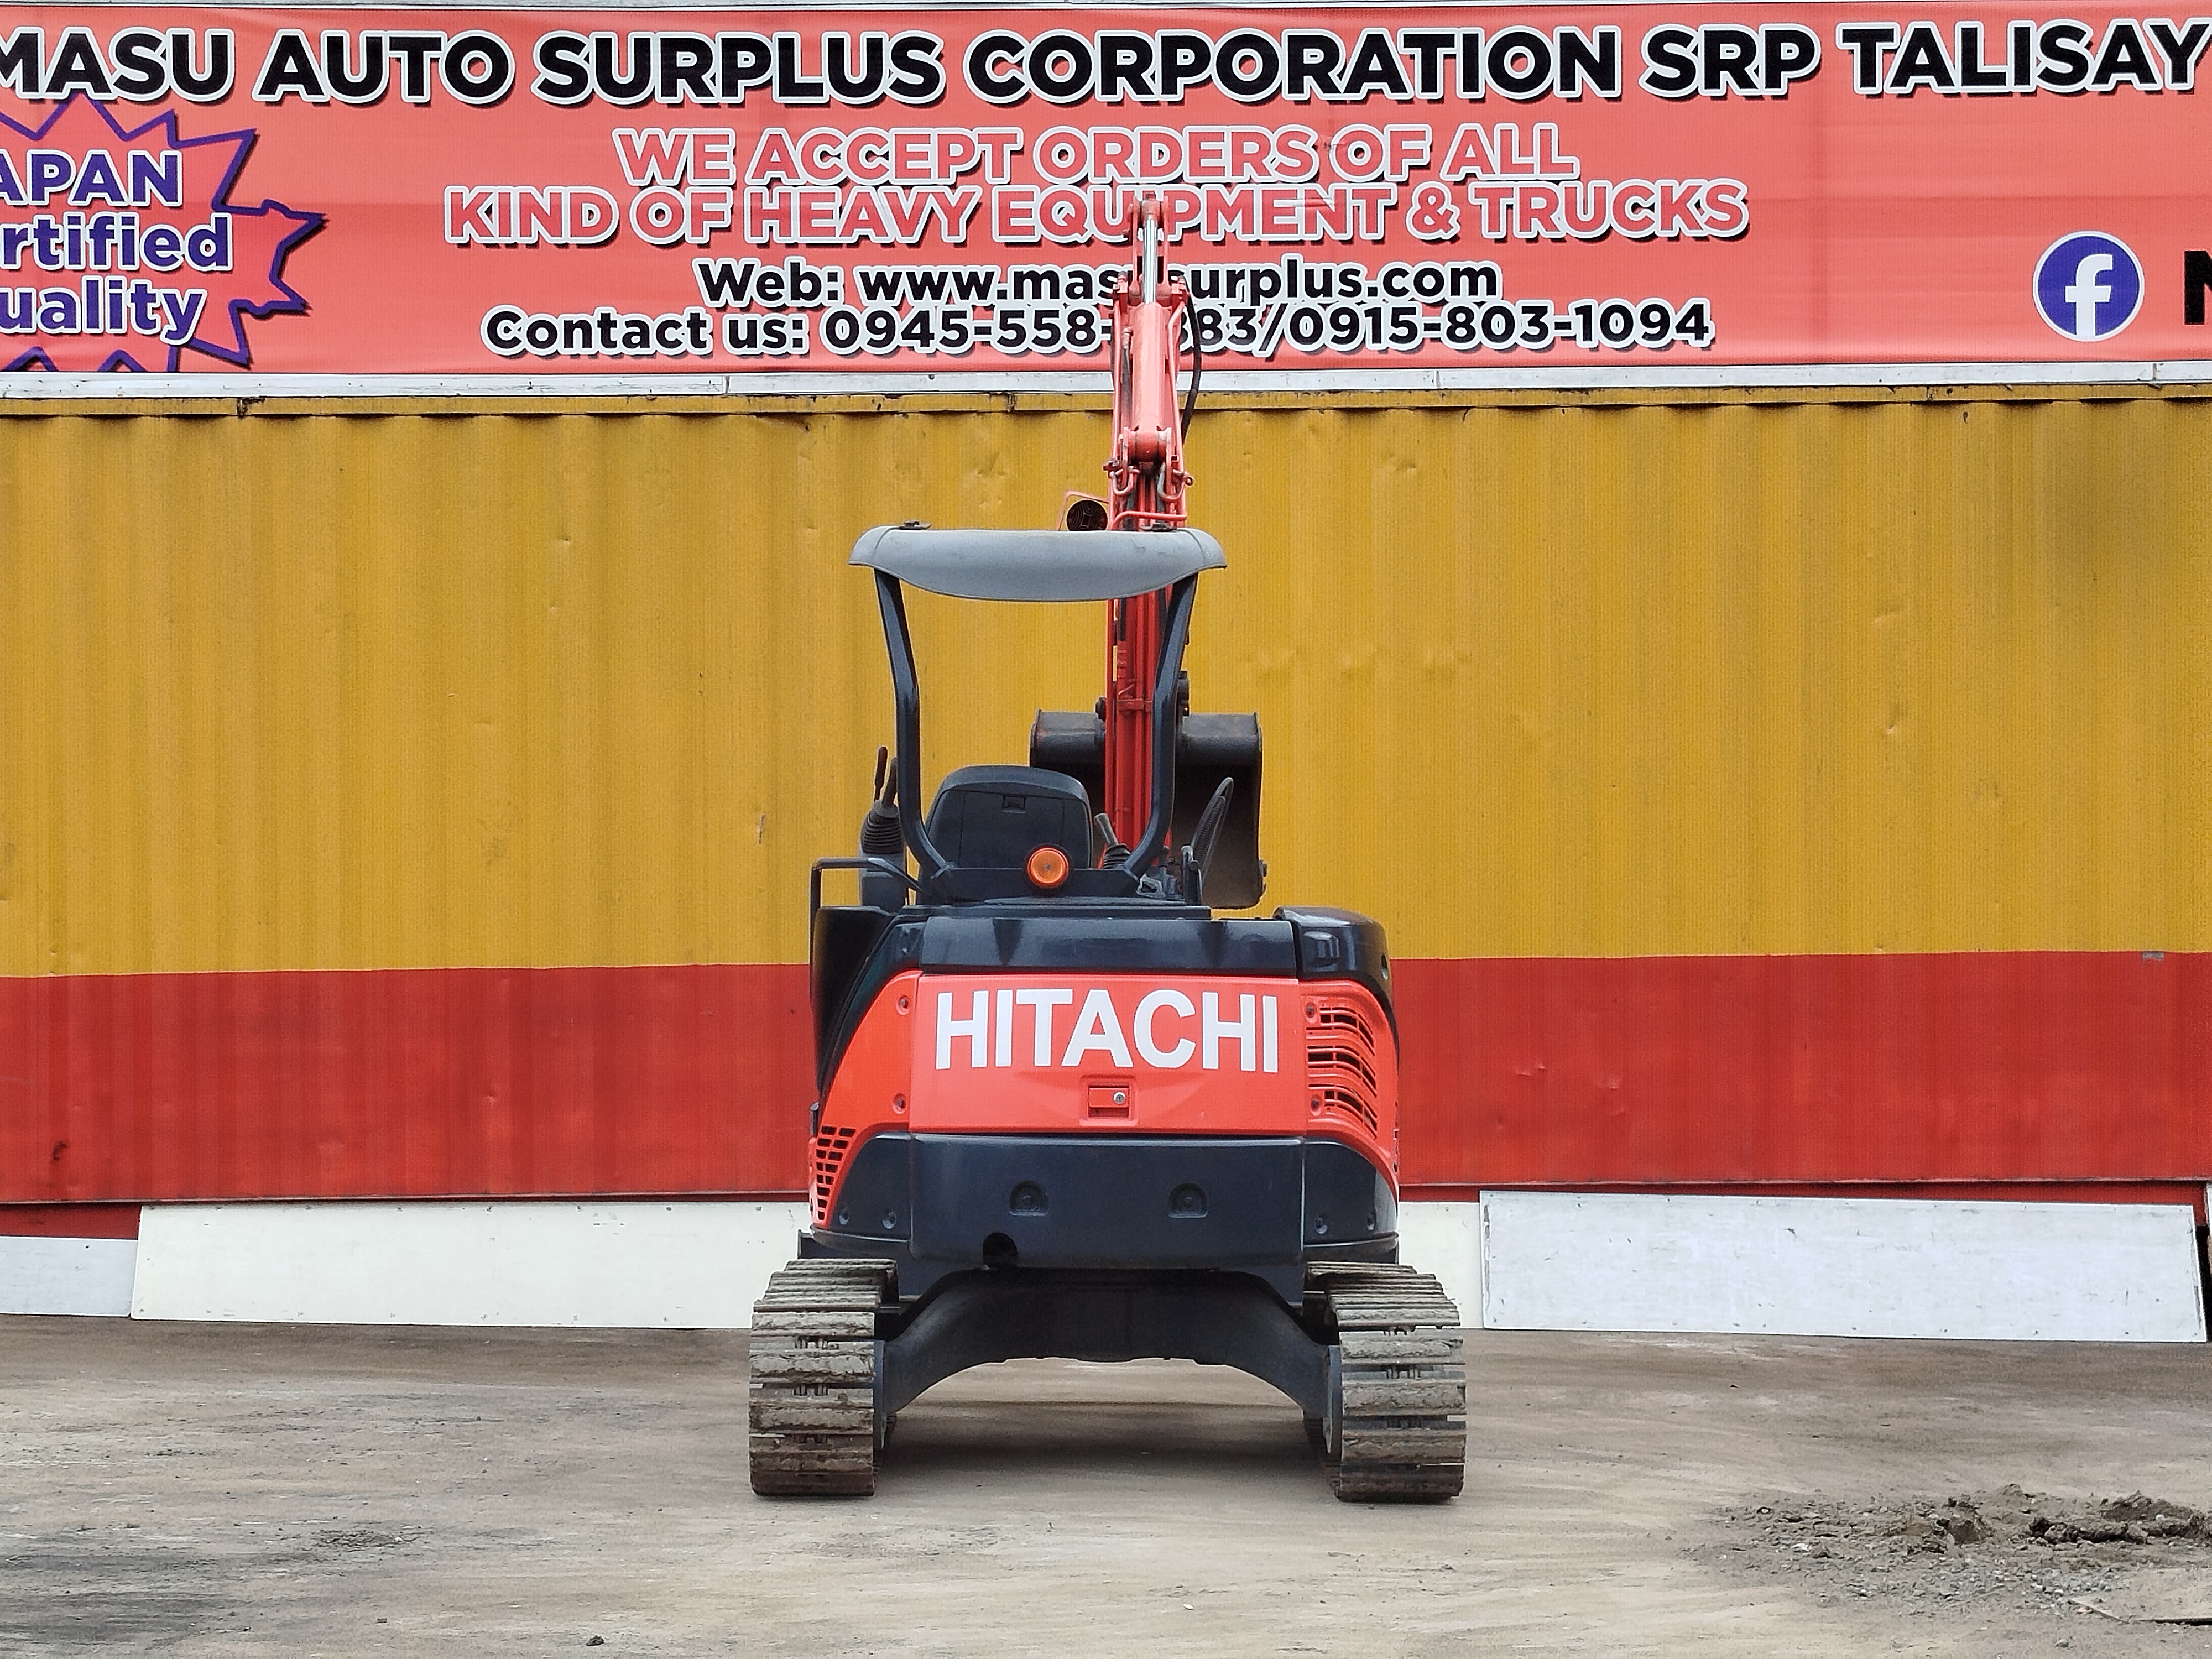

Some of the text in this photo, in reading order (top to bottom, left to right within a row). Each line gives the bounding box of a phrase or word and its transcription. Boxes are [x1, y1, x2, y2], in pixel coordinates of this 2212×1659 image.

[255, 32, 511, 100] AUTO
[535, 34, 942, 101] SURPLUS
[966, 30, 1618, 99] CORPORATION
[1643, 28, 1817, 94] SRP
[1840, 22, 2211, 89] TALISAY
[615, 127, 1576, 182] WE ACCEPT ORDERS OF ALL
[448, 183, 1746, 240] KIND OF HEAVY EQUPMENT & TRUCKS
[696, 260, 839, 304] Web:
[485, 309, 709, 351] Contact
[728, 317, 806, 351] us:
[935, 988, 1279, 1073] HITACHI
